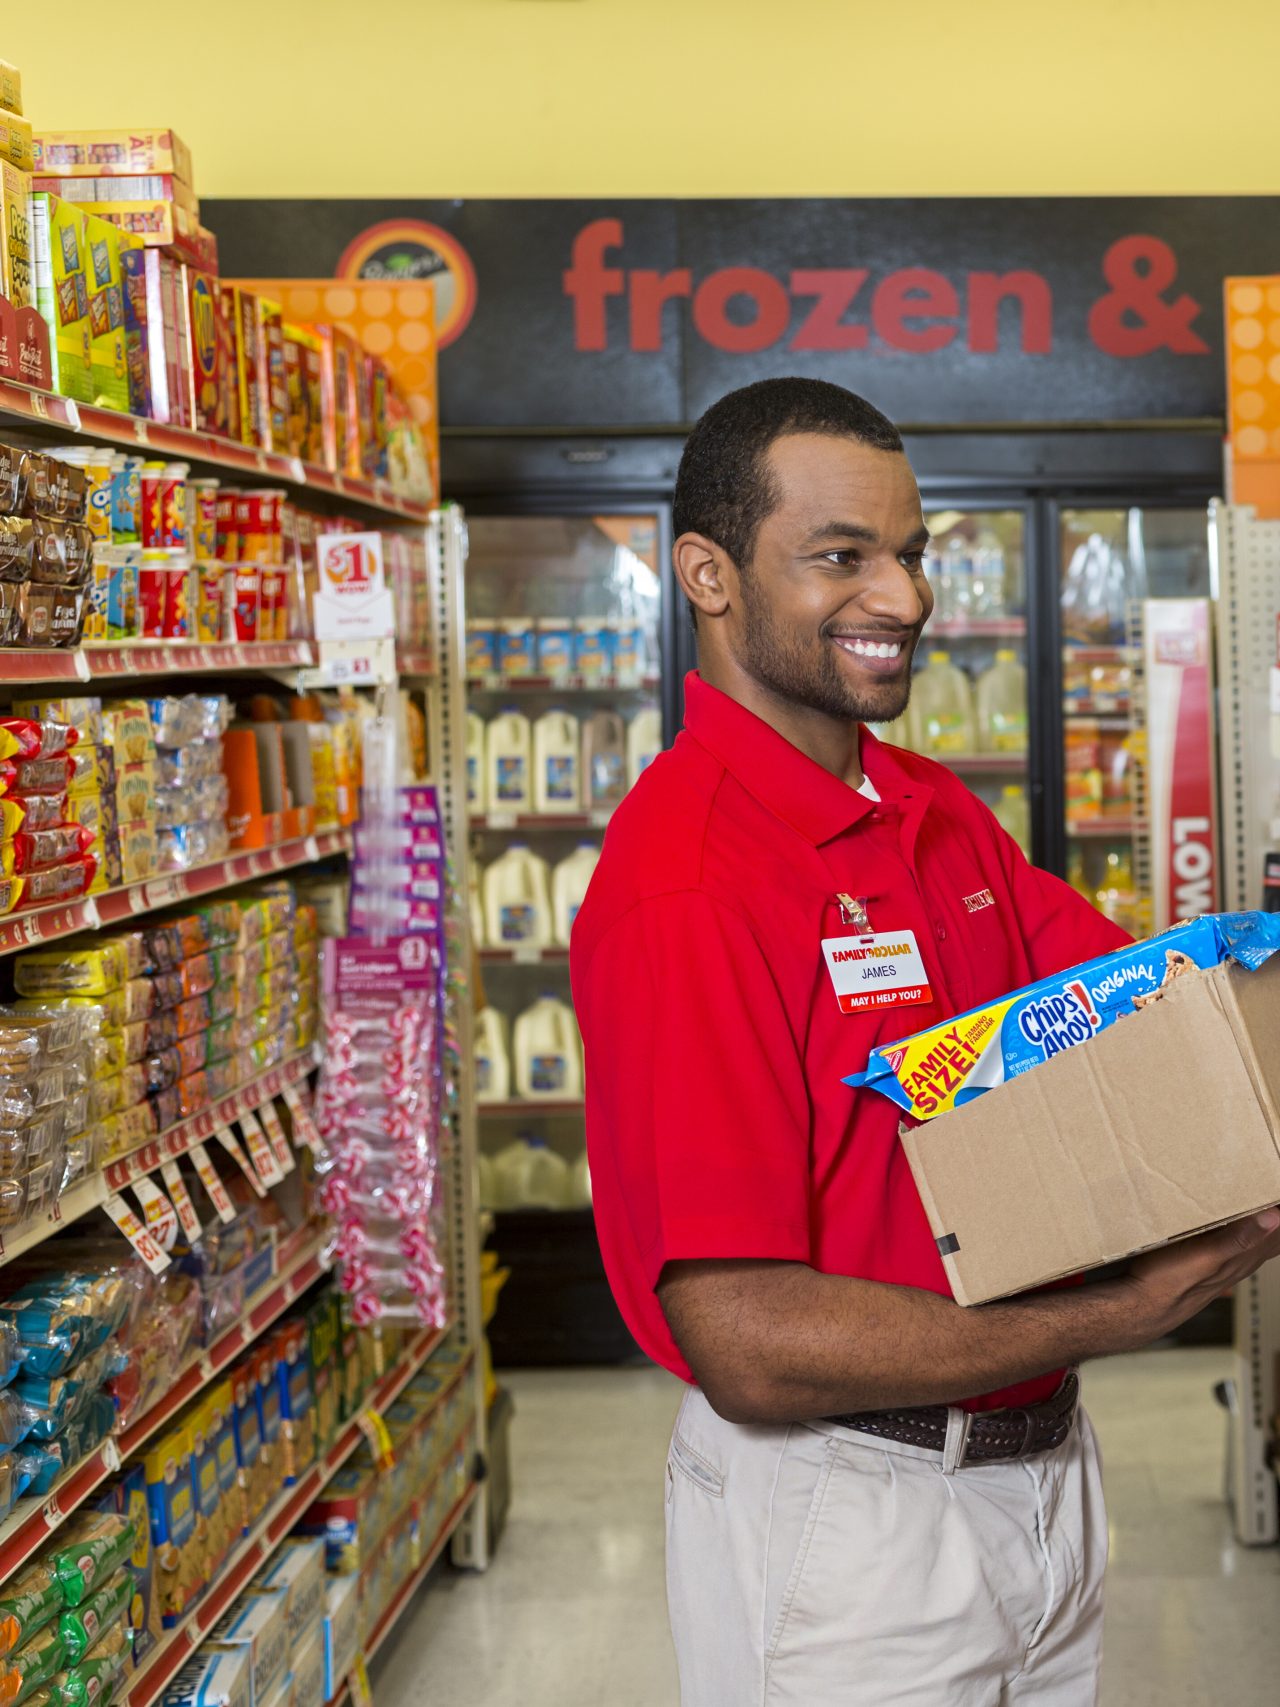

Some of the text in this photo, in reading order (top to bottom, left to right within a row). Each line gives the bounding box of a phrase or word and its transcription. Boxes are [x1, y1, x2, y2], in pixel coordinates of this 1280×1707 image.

[563, 218, 1212, 358] frozen &
[326, 543, 368, 584] $1
[1173, 817, 1213, 918] LOW
[832, 943, 912, 962] FAMILY DOLLAR
[862, 965, 897, 979] JAMES
[851, 989, 922, 1007] MAY I HELP YOU?
[1091, 964, 1157, 1004] ORIGINAL
[965, 1015, 989, 1040] TAMAÑO
[969, 1017, 996, 1046] FAMILIAR
[1020, 991, 1079, 1042] Chips
[1043, 983, 1099, 1060] Ahoy!
[901, 1025, 965, 1097] FAMILY
[915, 1042, 980, 1114] SIZE!
